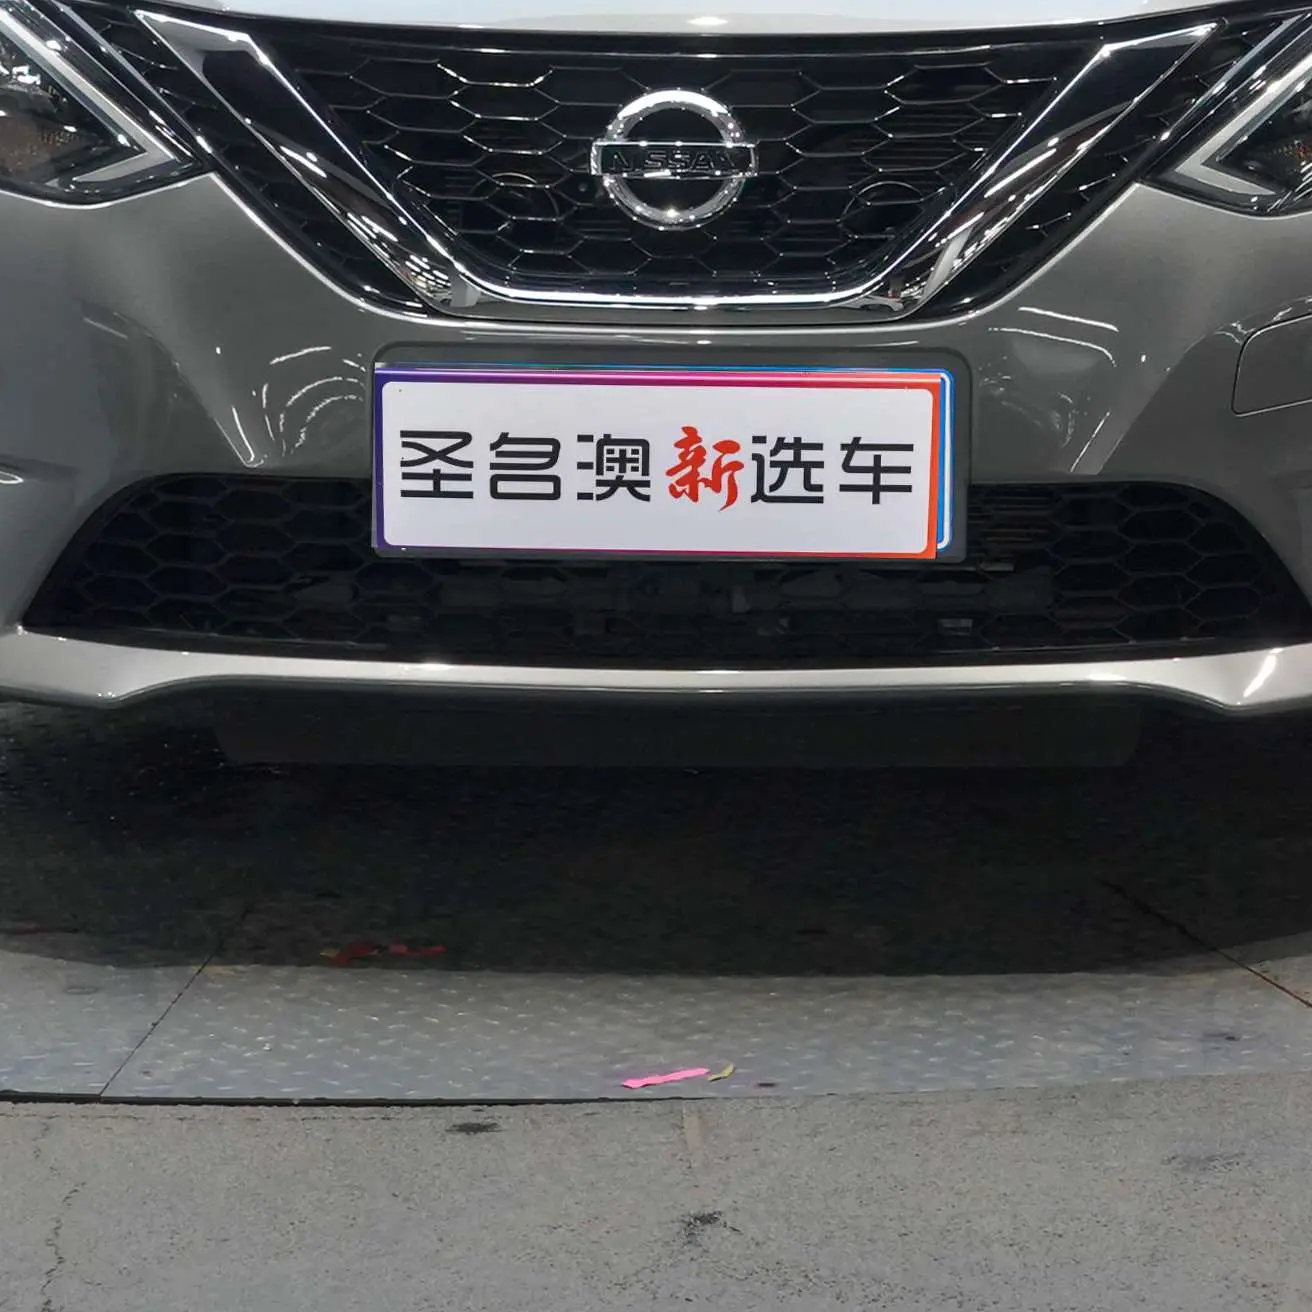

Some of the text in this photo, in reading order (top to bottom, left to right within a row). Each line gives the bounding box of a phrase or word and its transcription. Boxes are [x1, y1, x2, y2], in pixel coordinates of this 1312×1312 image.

[399, 426, 914, 511] 圣名澳新选车
